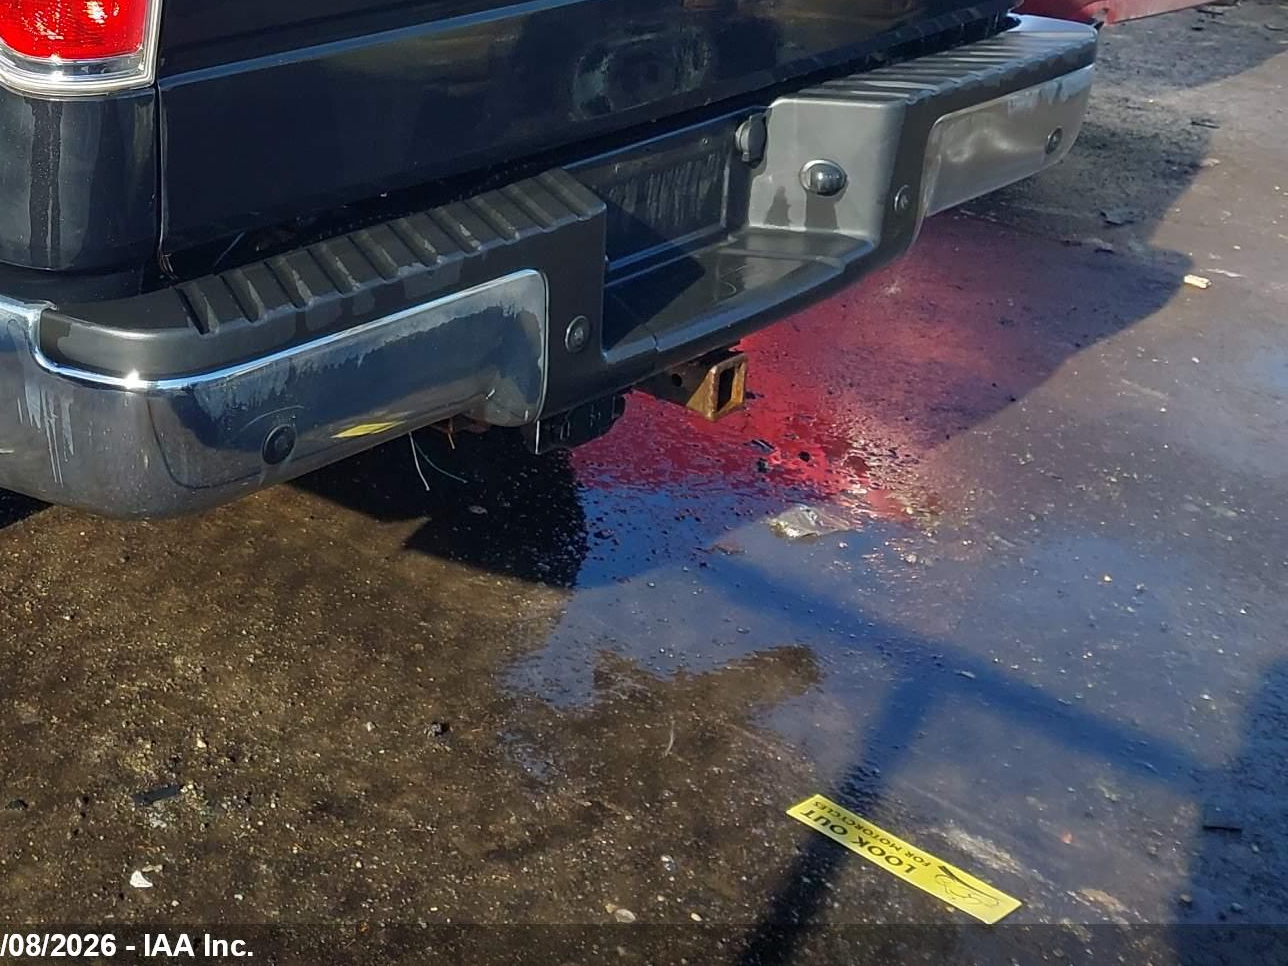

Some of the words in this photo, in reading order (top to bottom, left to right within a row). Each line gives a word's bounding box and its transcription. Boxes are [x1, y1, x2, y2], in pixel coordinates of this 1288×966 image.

[800, 809, 849, 837] OUT
[813, 801, 902, 850] MOTORCYCLES
[853, 836, 917, 874] LOOK
[905, 850, 931, 868] FOR
